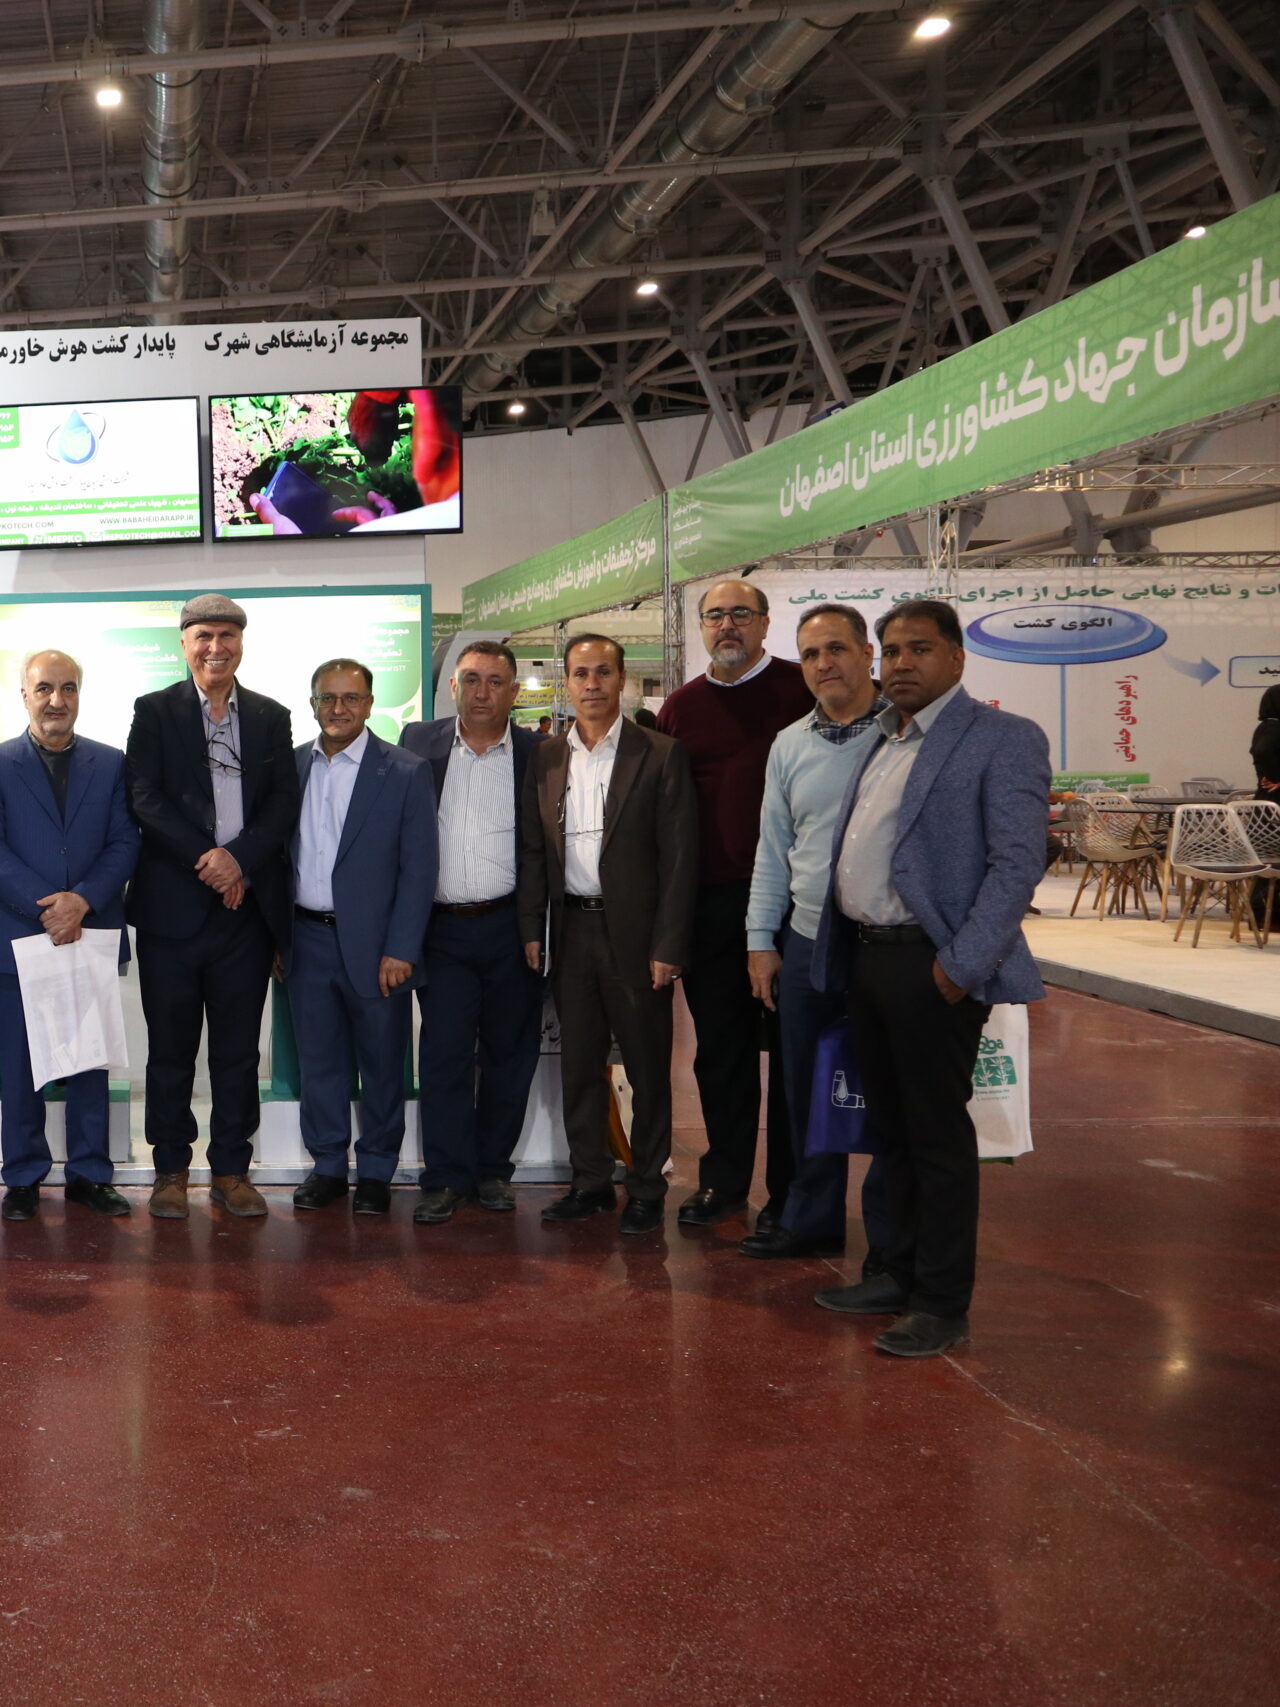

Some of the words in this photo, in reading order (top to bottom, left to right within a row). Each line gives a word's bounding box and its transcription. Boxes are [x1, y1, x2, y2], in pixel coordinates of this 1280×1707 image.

[49, 337, 88, 362] هوش
[92, 333, 129, 354] کشت
[133, 331, 176, 359] پایدار
[204, 332, 251, 357] شهرک
[255, 323, 347, 355] آزمایشگاهی
[351, 329, 409, 352] مجموعه
[1054, 336, 1148, 404] جهاد
[916, 357, 1049, 469] کشاورزی
[851, 413, 914, 491] استان
[780, 441, 851, 518] اصفهان
[602, 540, 634, 577] تحقیقات
[788, 589, 828, 604] ملی
[834, 587, 885, 600] کشت
[958, 586, 1023, 602] اجرای
[1029, 586, 1048, 601] از
[1054, 585, 1115, 600] حاصل
[1122, 584, 1177, 600] نهایی
[1183, 583, 1232, 599] نتایج
[1238, 587, 1251, 599] و
[1013, 617, 1056, 629] کشت
[1061, 616, 1113, 631] الگوی
[1114, 675, 1138, 725] راهبردهای
[1113, 728, 1136, 762] حمایتی
